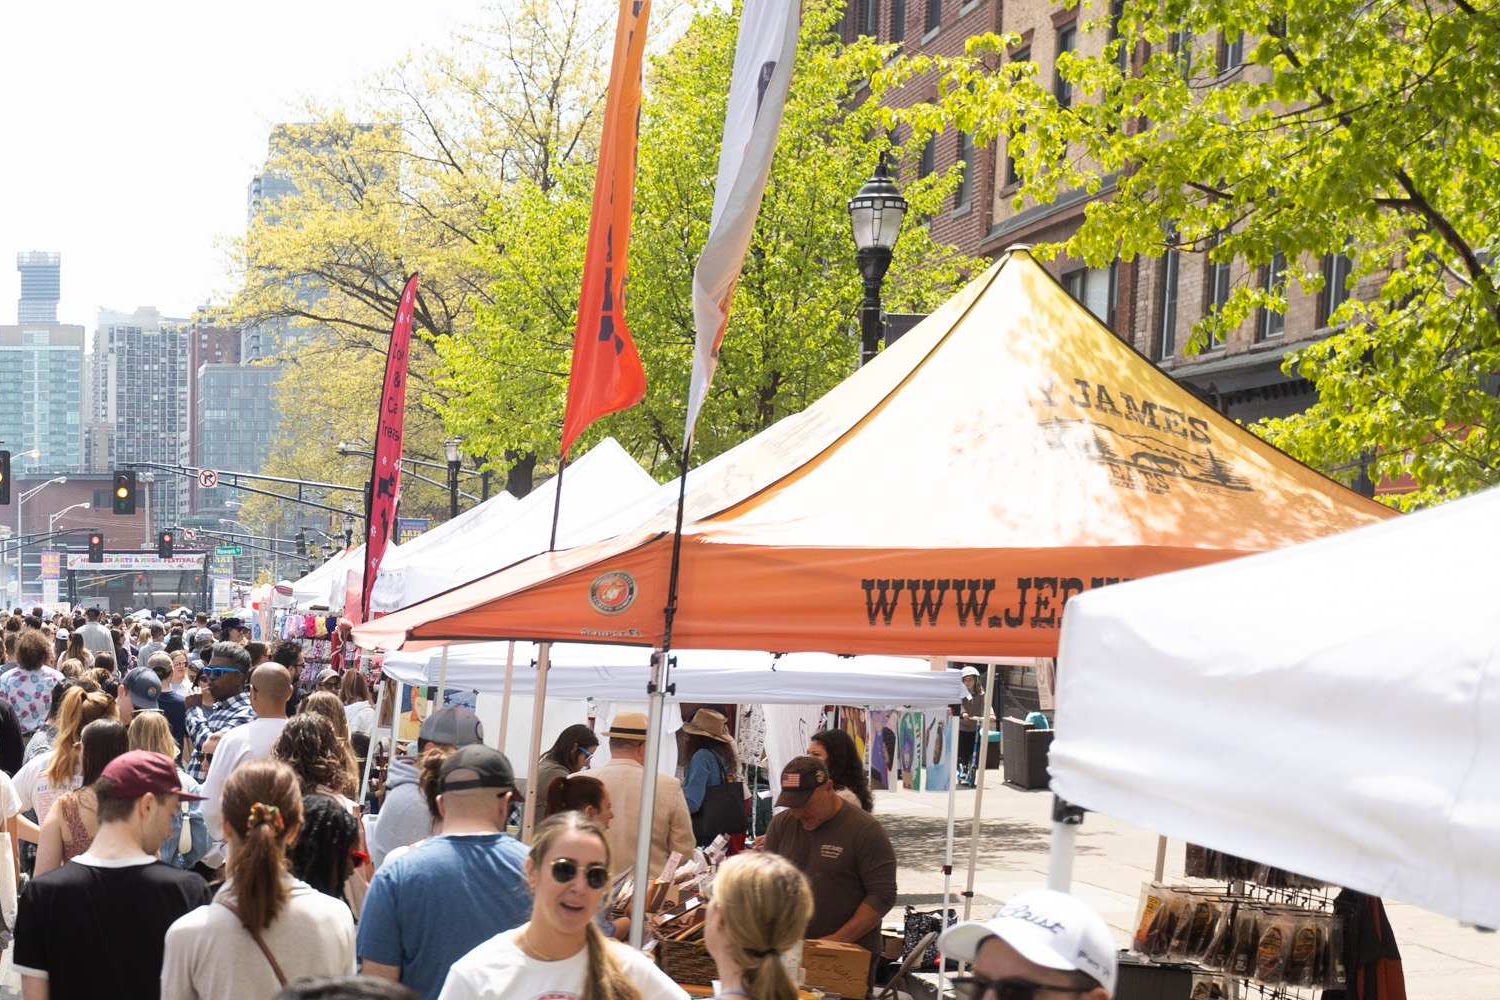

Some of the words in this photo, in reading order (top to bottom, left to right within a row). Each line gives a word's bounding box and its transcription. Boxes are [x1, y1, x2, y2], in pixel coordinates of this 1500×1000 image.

[394, 371, 401, 388] &
[1069, 378, 1212, 445] JAMES
[1108, 462, 1171, 490] EATS
